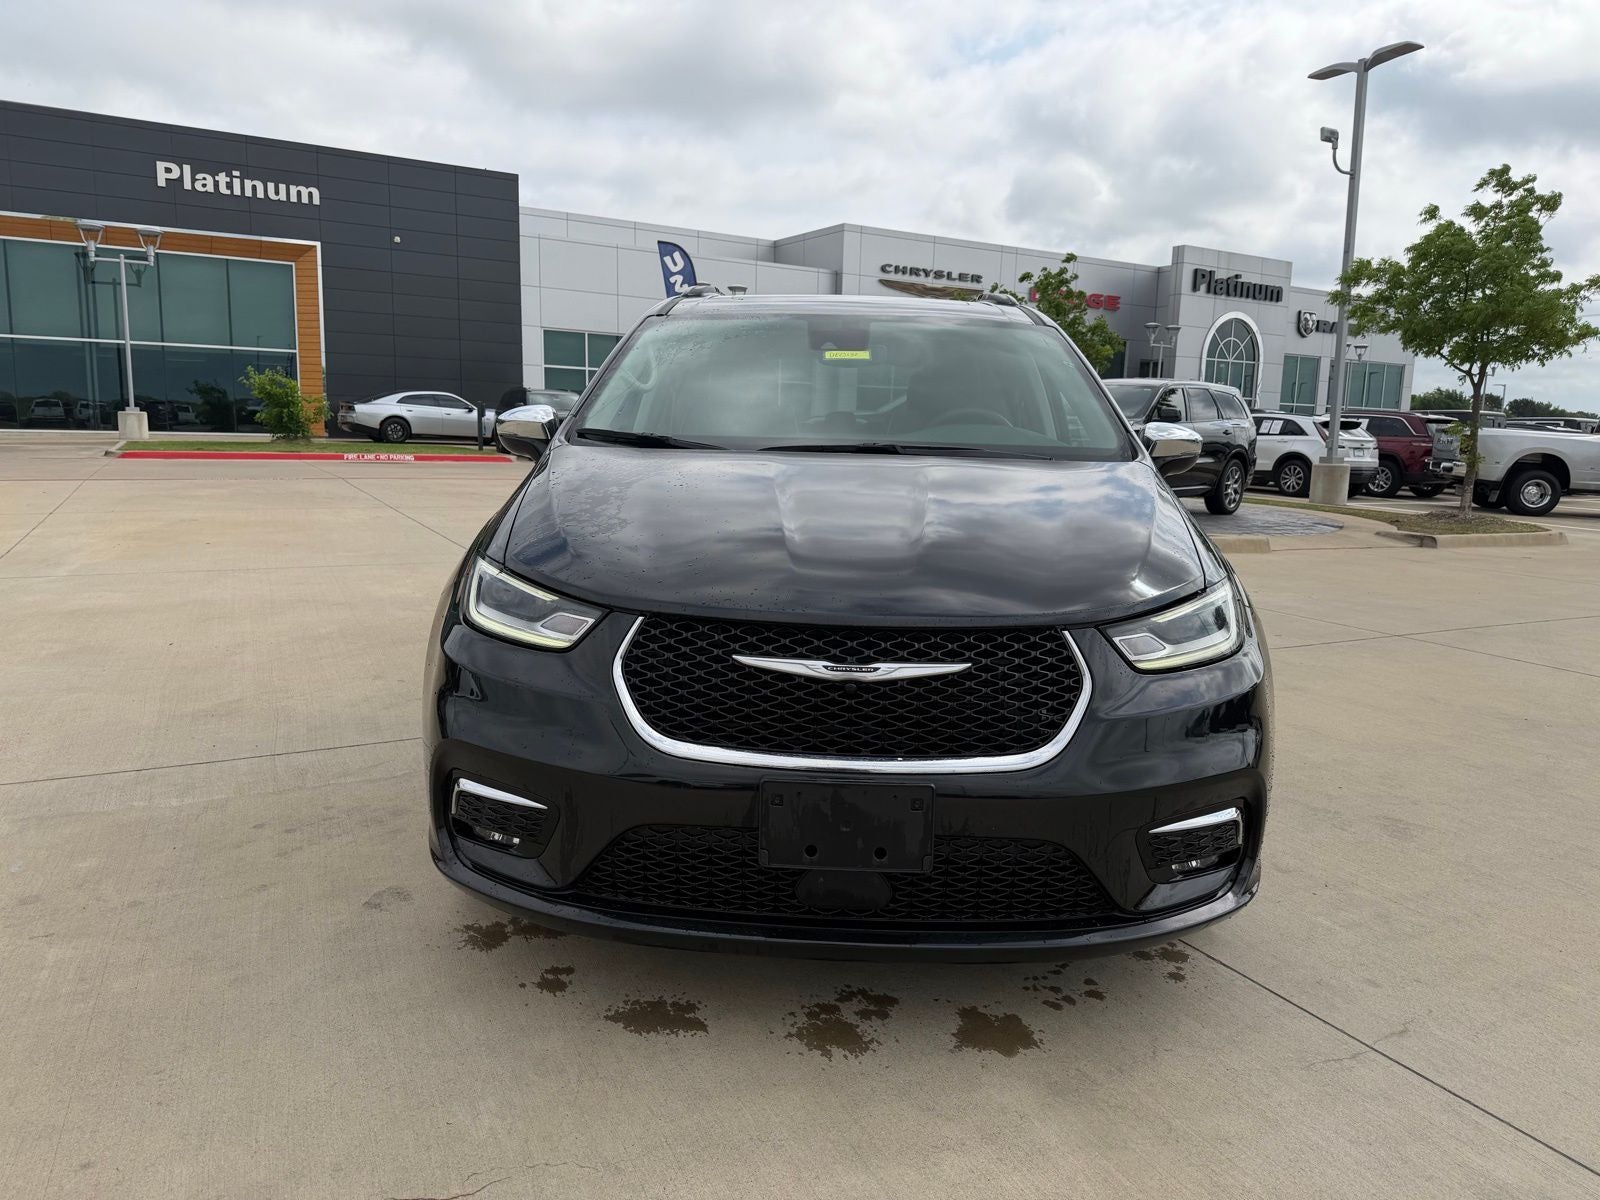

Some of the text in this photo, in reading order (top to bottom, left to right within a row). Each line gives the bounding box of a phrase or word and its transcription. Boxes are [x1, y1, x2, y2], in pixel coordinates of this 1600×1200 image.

[155, 160, 321, 206] Platinum
[880, 263, 983, 283] CHRYSLER
[1191, 267, 1284, 303] Platinum
[389, 453, 415, 461] PARKING
